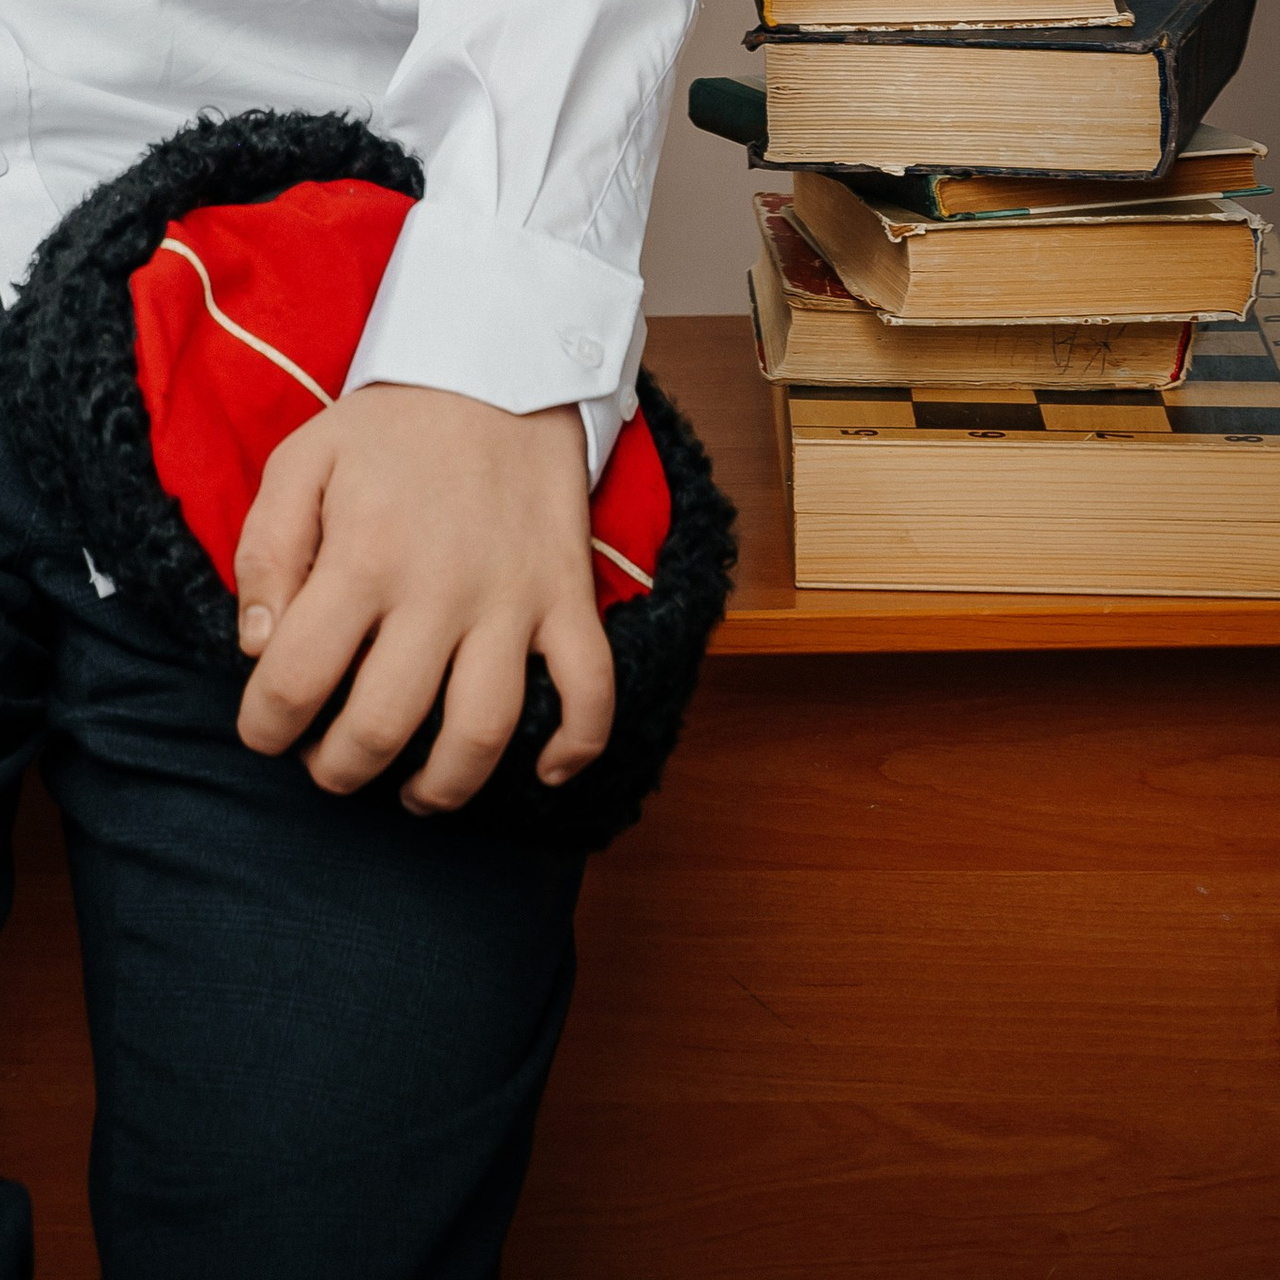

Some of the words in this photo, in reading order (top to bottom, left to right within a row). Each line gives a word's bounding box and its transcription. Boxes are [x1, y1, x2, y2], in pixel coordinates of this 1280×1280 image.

[841, 428, 879, 438] 5
[968, 431, 1007, 439] 6
[1096, 432, 1135, 440] 7
[1224, 435, 1264, 443] 8
